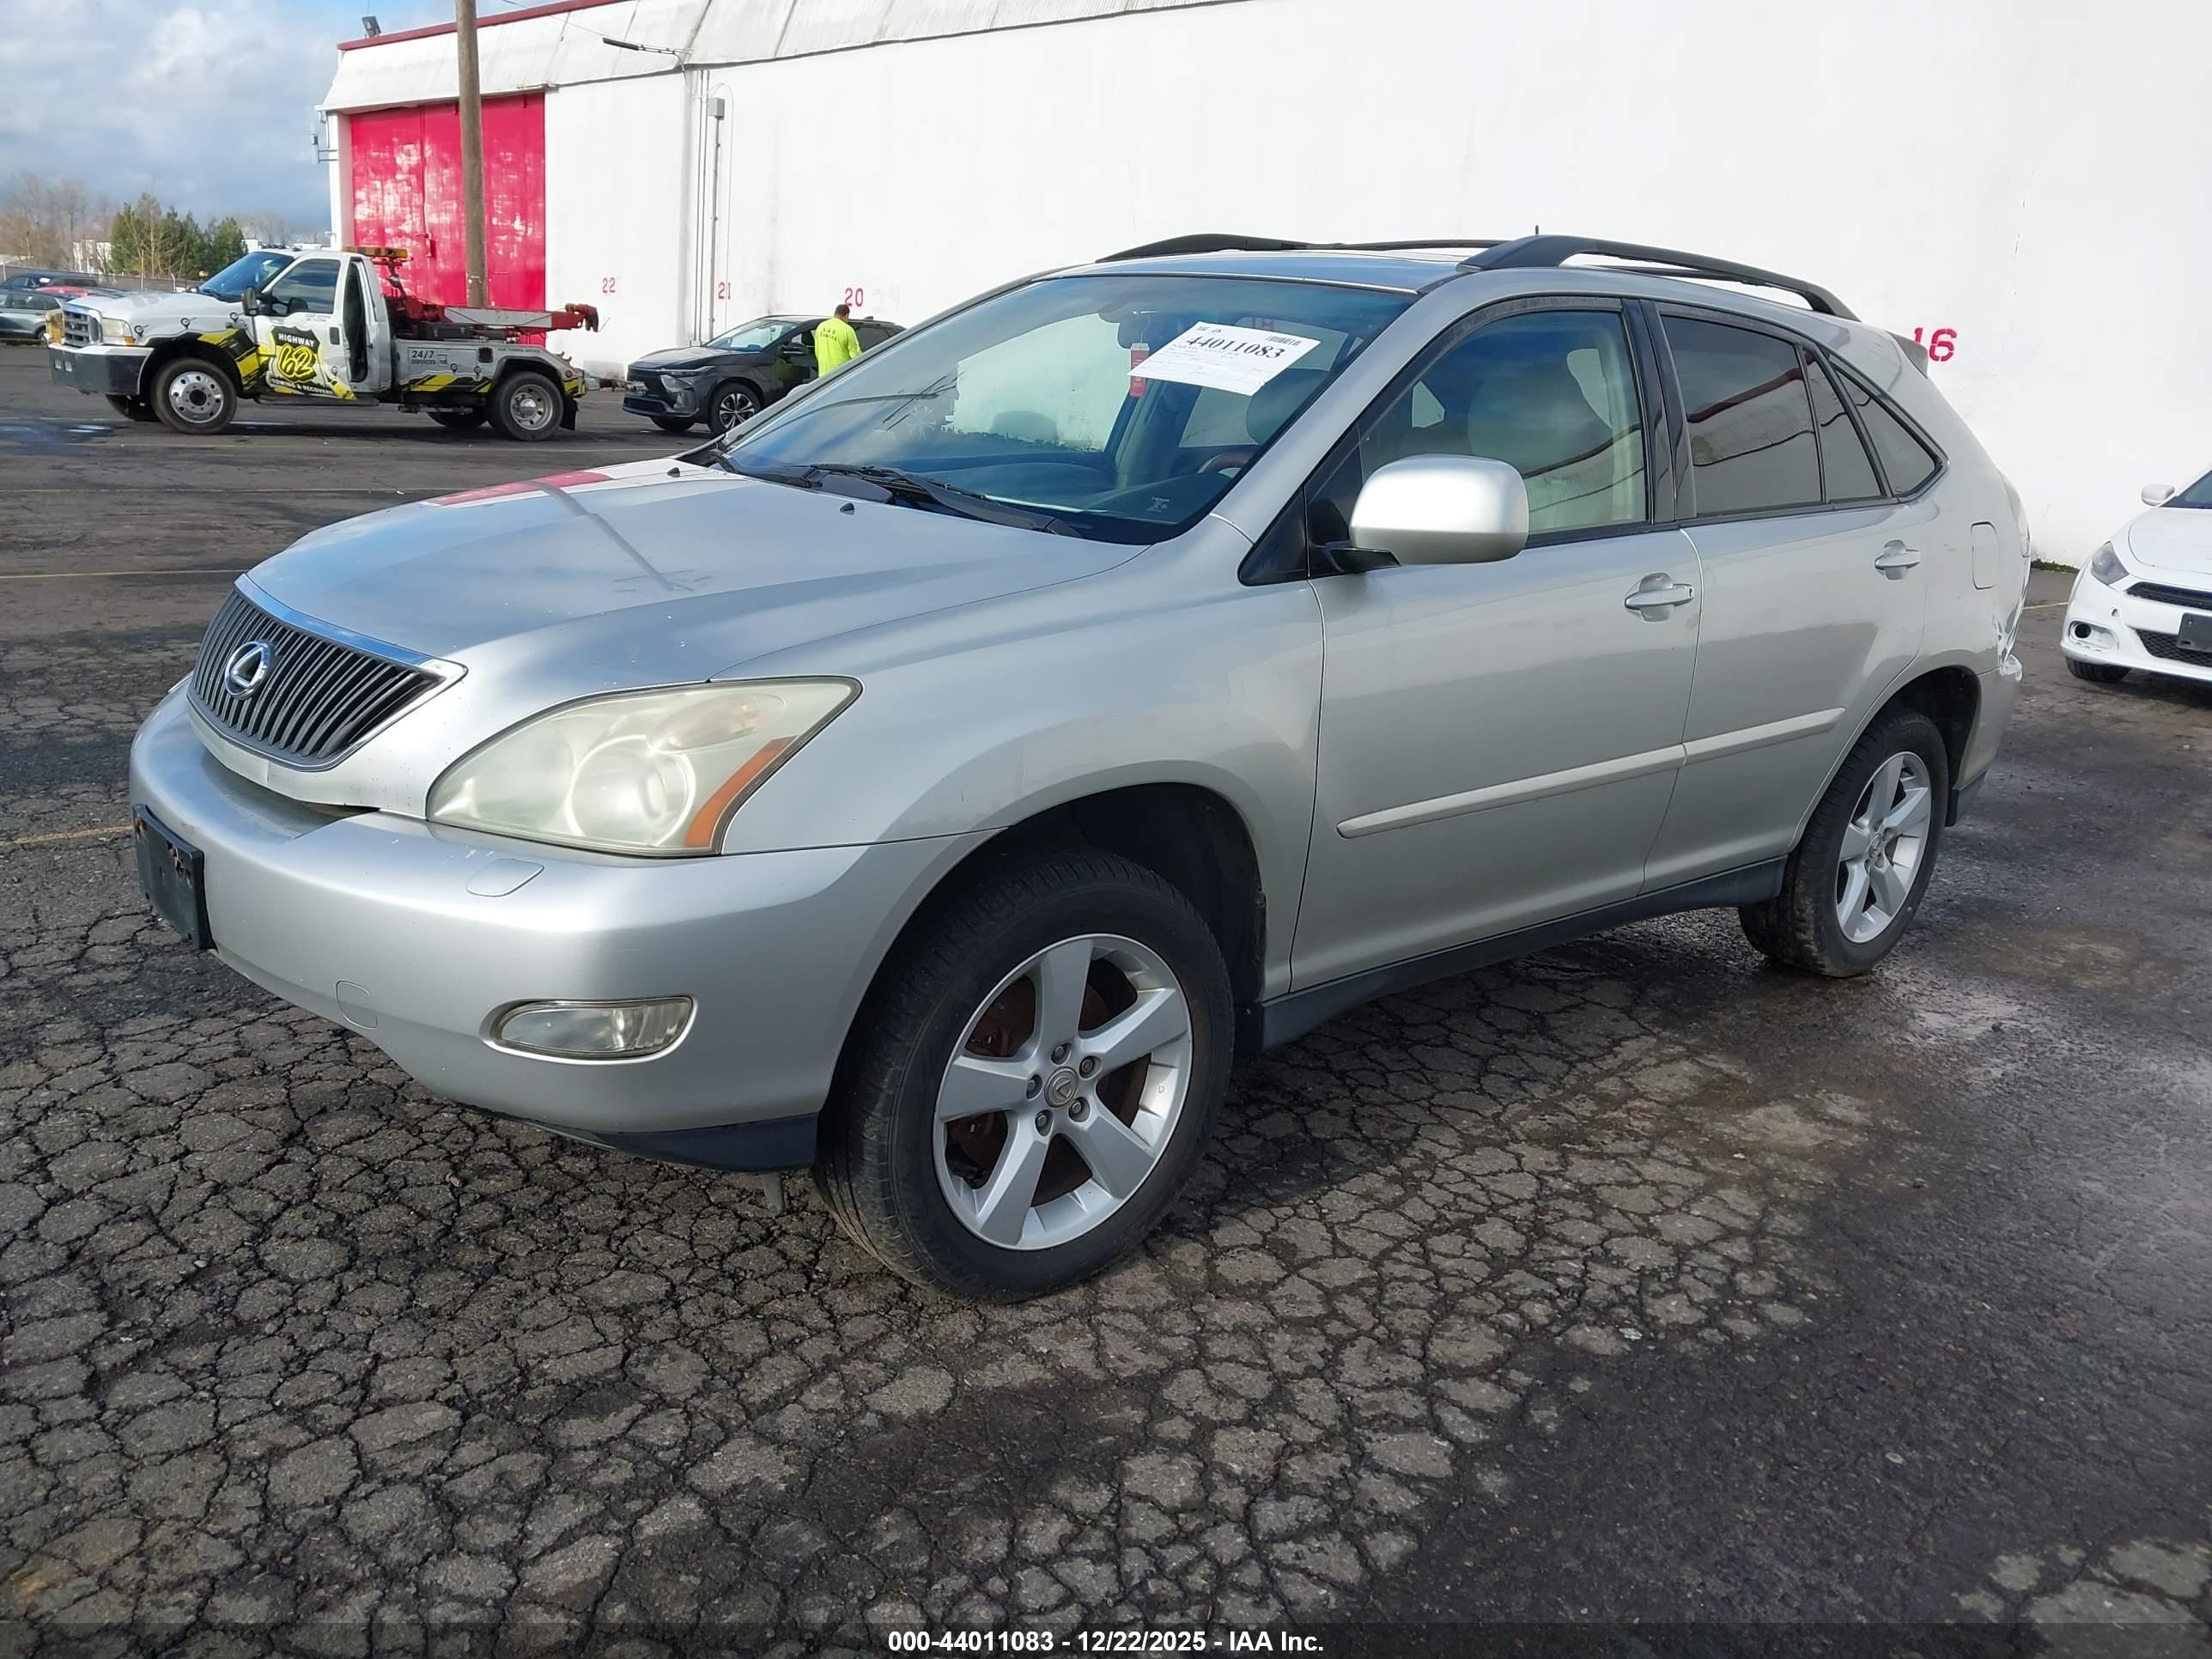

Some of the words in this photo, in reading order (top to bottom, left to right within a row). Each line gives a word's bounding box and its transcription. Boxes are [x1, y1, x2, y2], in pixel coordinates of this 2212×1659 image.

[602, 277, 616, 293] 22
[718, 282, 731, 300] 21
[845, 288, 864, 307] 20
[277, 332, 315, 348] HIGHWAY
[1187, 336, 1285, 358] 44011083
[277, 343, 315, 379] 62
[412, 349, 434, 359] 24/7
